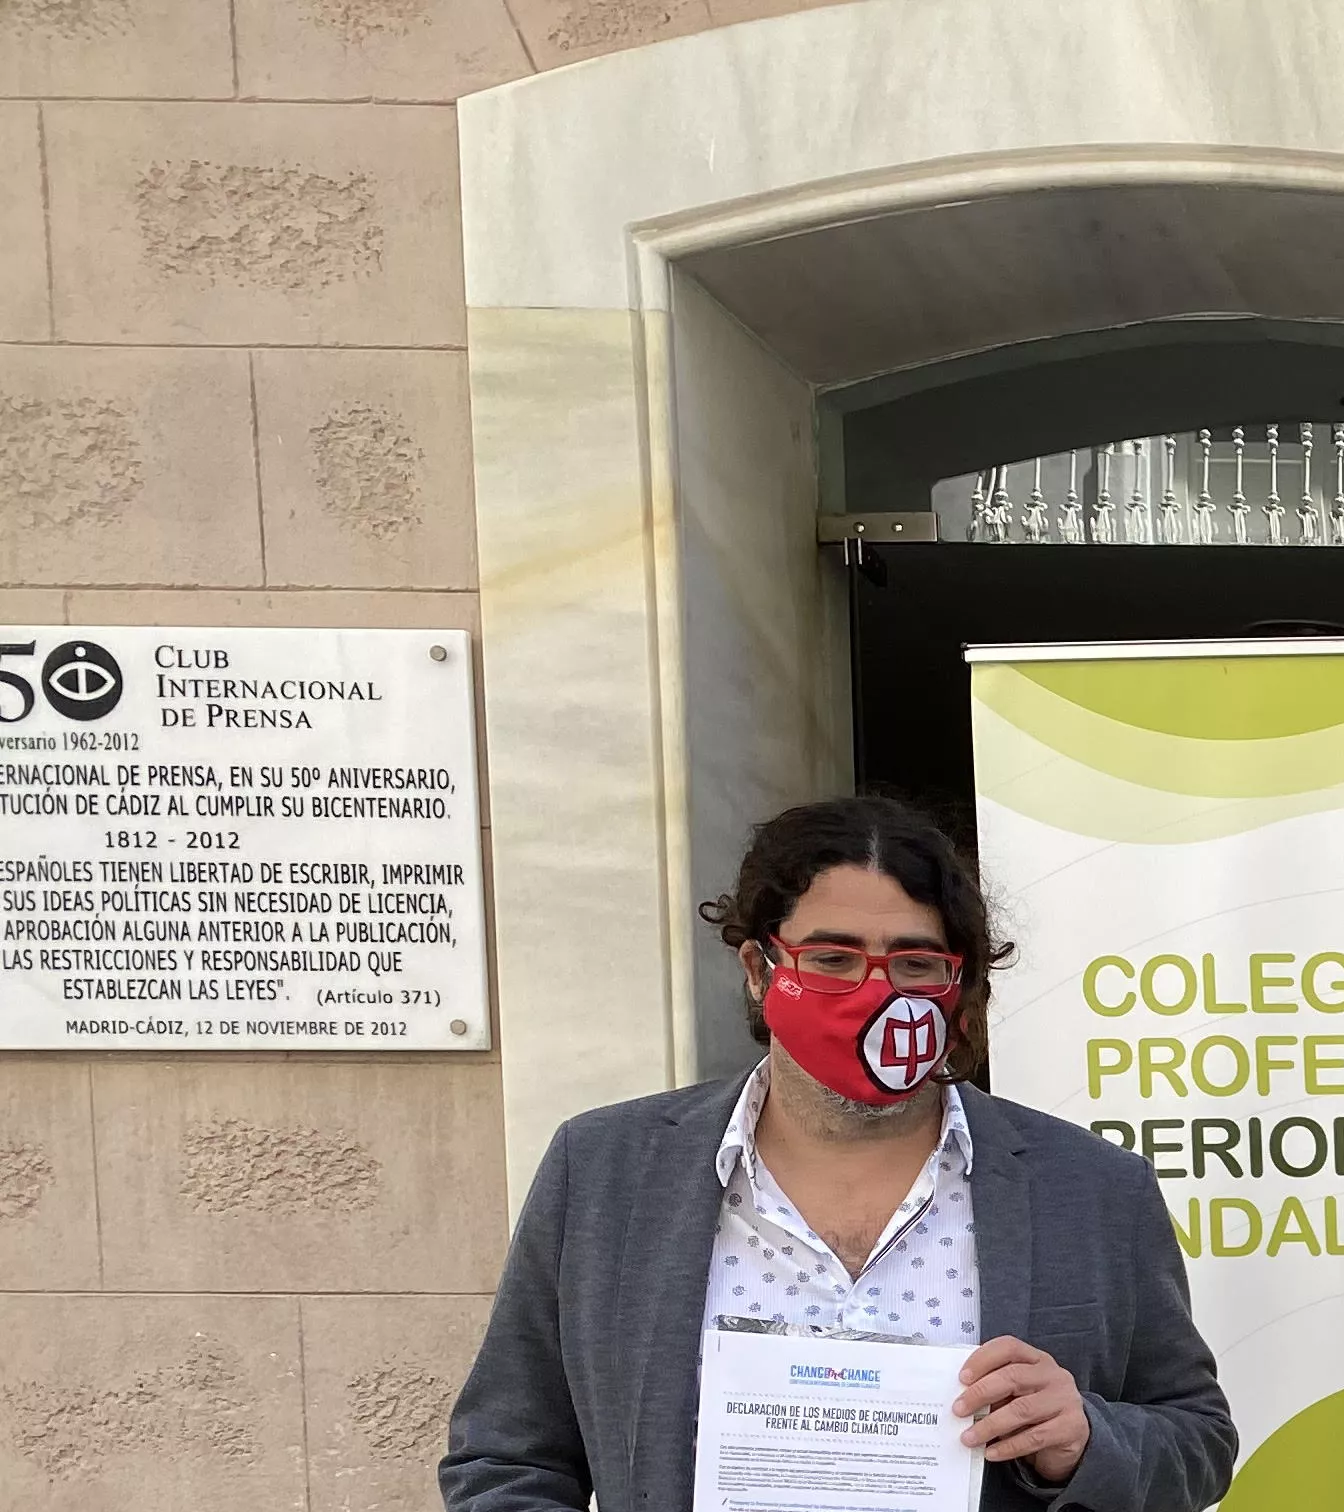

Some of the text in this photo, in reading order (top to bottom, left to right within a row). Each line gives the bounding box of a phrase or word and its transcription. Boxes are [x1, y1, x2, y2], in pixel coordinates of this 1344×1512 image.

[62, 732, 139, 751] 1962-2012
[117, 765, 140, 786] DE
[148, 766, 223, 791] PRENSA,
[230, 766, 253, 788] EN
[260, 766, 283, 788] SU
[327, 767, 456, 794] ANIVERSARIO,
[76, 794, 99, 815] DE
[106, 786, 161, 816] CÁDIZ
[167, 795, 188, 816] AL
[195, 795, 274, 817] CUMPLIR
[281, 796, 304, 817] SU
[312, 797, 451, 819] BICENTENARIO.
[105, 831, 157, 848] 1812
[186, 831, 240, 849] 2012
[99, 861, 162, 883] TIENEN
[169, 862, 253, 883] LIBERTAD
[260, 863, 283, 883] DE
[290, 863, 375, 889] ESCRIBIR,
[382, 864, 464, 885] IMPRIMIR
[3, 884, 453, 918] SUS IDEAS POLÍTICAS SIN NECESIDAD DE LICENCIA,
[4, 913, 457, 948] APROBACIÓN ALGUNA ANTERIOR A LA PUBLICACIÓN,
[2, 949, 403, 976] LAS RESTRICCIONES Y RESPONSABILIDAD QUE
[63, 979, 181, 1000] ESTABLEZCAN
[188, 979, 219, 1000] LAS
[316, 989, 441, 1007] (Artículo 371)
[66, 1016, 407, 1037] MADRID-CÁDIZ, 12 DE NOVIEMBRE DE 2012
[790, 1405, 801, 1417] DE
[803, 1406, 820, 1419] LOS
[822, 1407, 856, 1421] MEDIOS
[859, 1409, 869, 1421] DE
[765, 1416, 798, 1430] FRENTE
[801, 1418, 812, 1431] AL
[814, 1419, 849, 1433] CAMBIO
